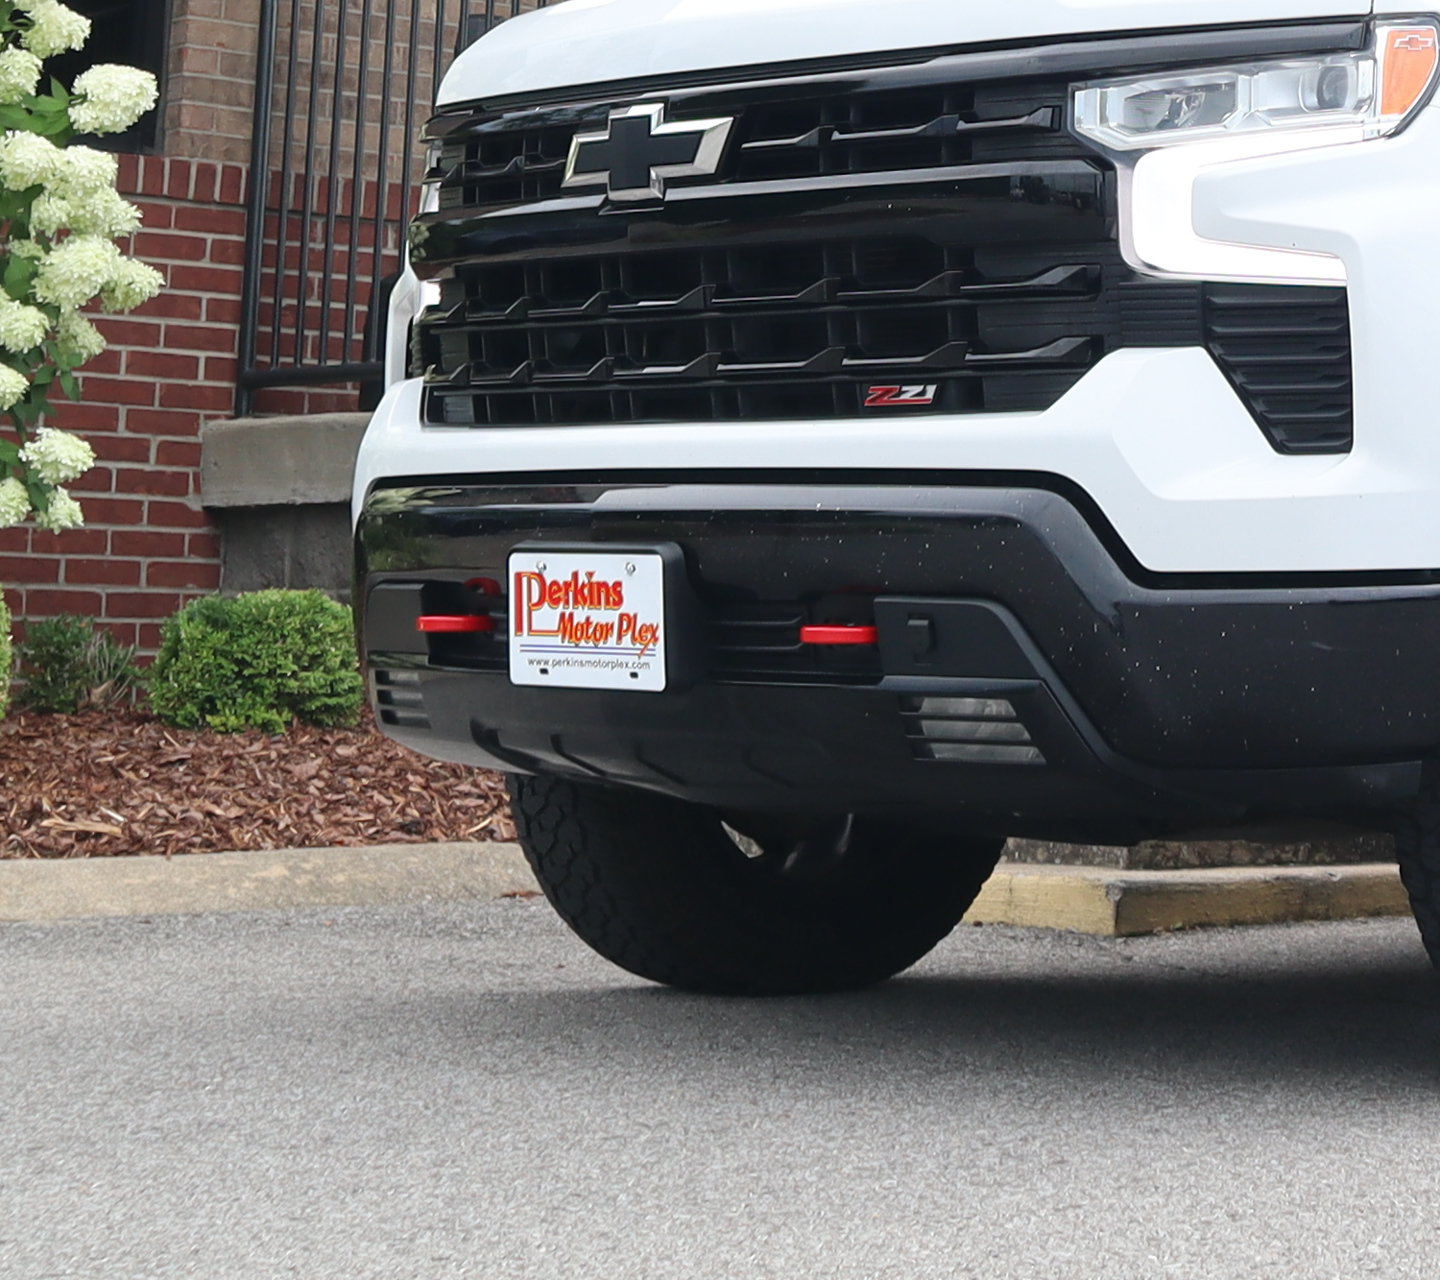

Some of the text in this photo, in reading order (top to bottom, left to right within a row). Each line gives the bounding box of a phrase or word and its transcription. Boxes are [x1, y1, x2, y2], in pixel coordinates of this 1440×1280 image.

[864, 384, 937, 406] Z71
[514, 571, 623, 636] Perkins
[558, 611, 659, 657] Motor Plex
[528, 657, 650, 671] www.perkinsmotorplex.com
